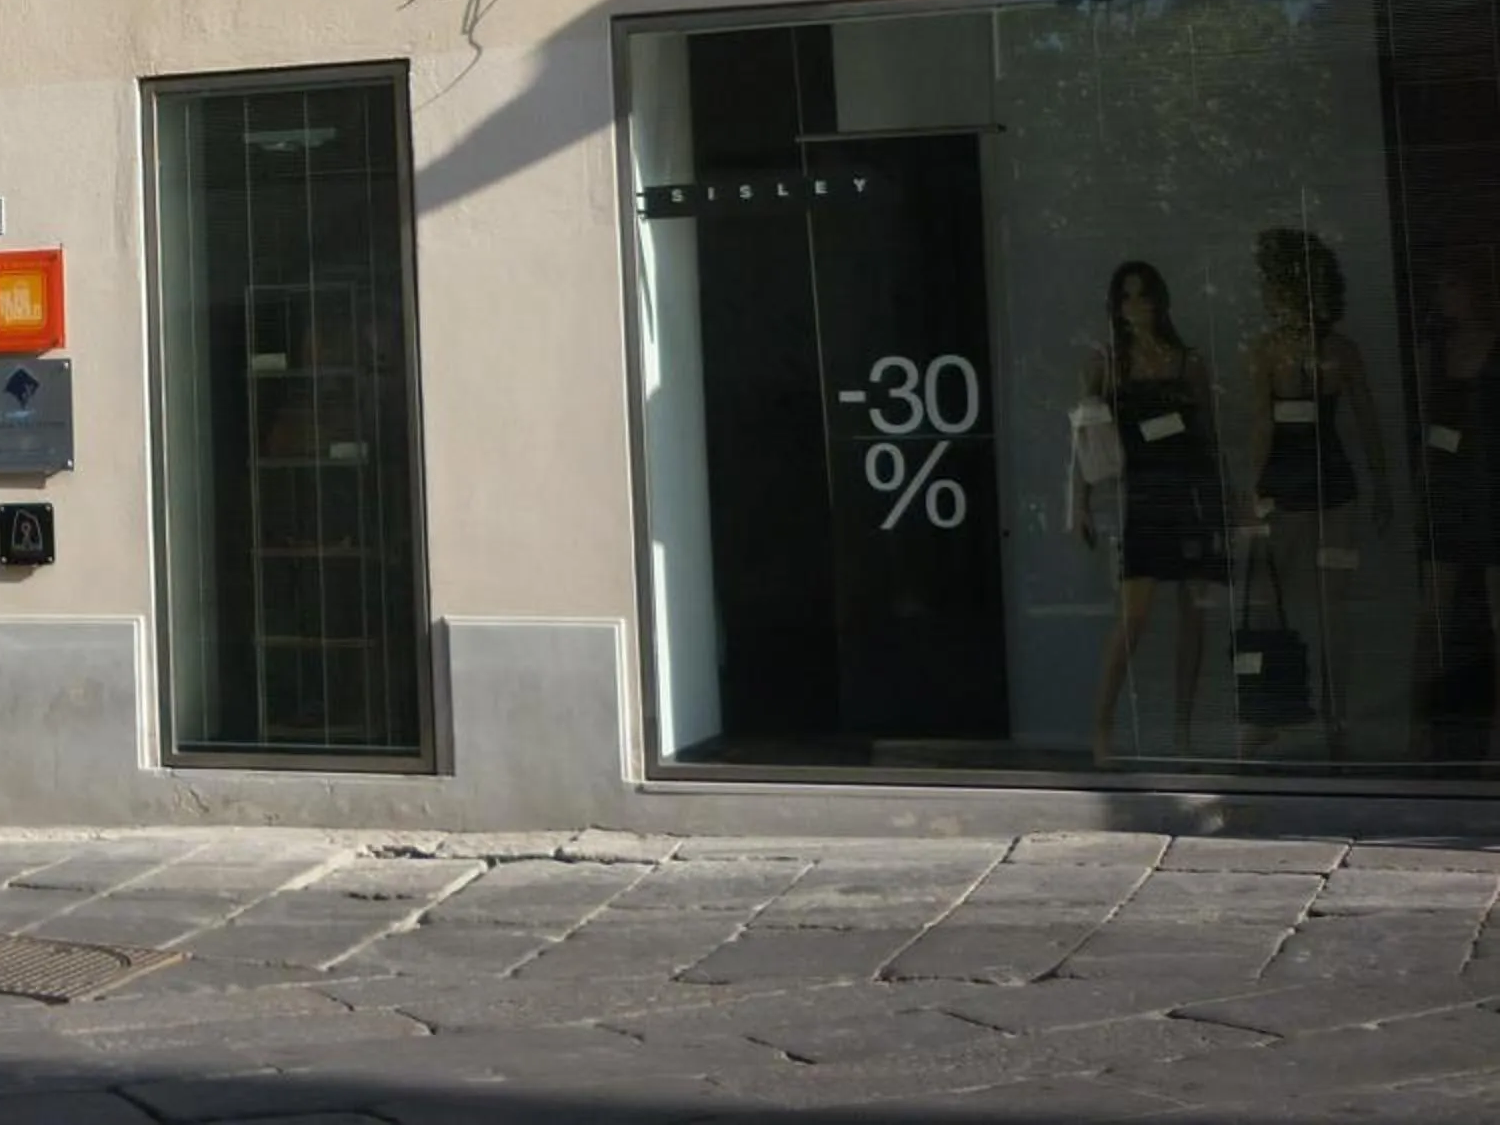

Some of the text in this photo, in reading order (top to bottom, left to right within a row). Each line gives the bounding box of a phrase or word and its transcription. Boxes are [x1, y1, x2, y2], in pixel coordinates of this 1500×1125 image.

[671, 178, 868, 203] SISLEY
[838, 354, 980, 435] -30
[864, 439, 967, 531] %
